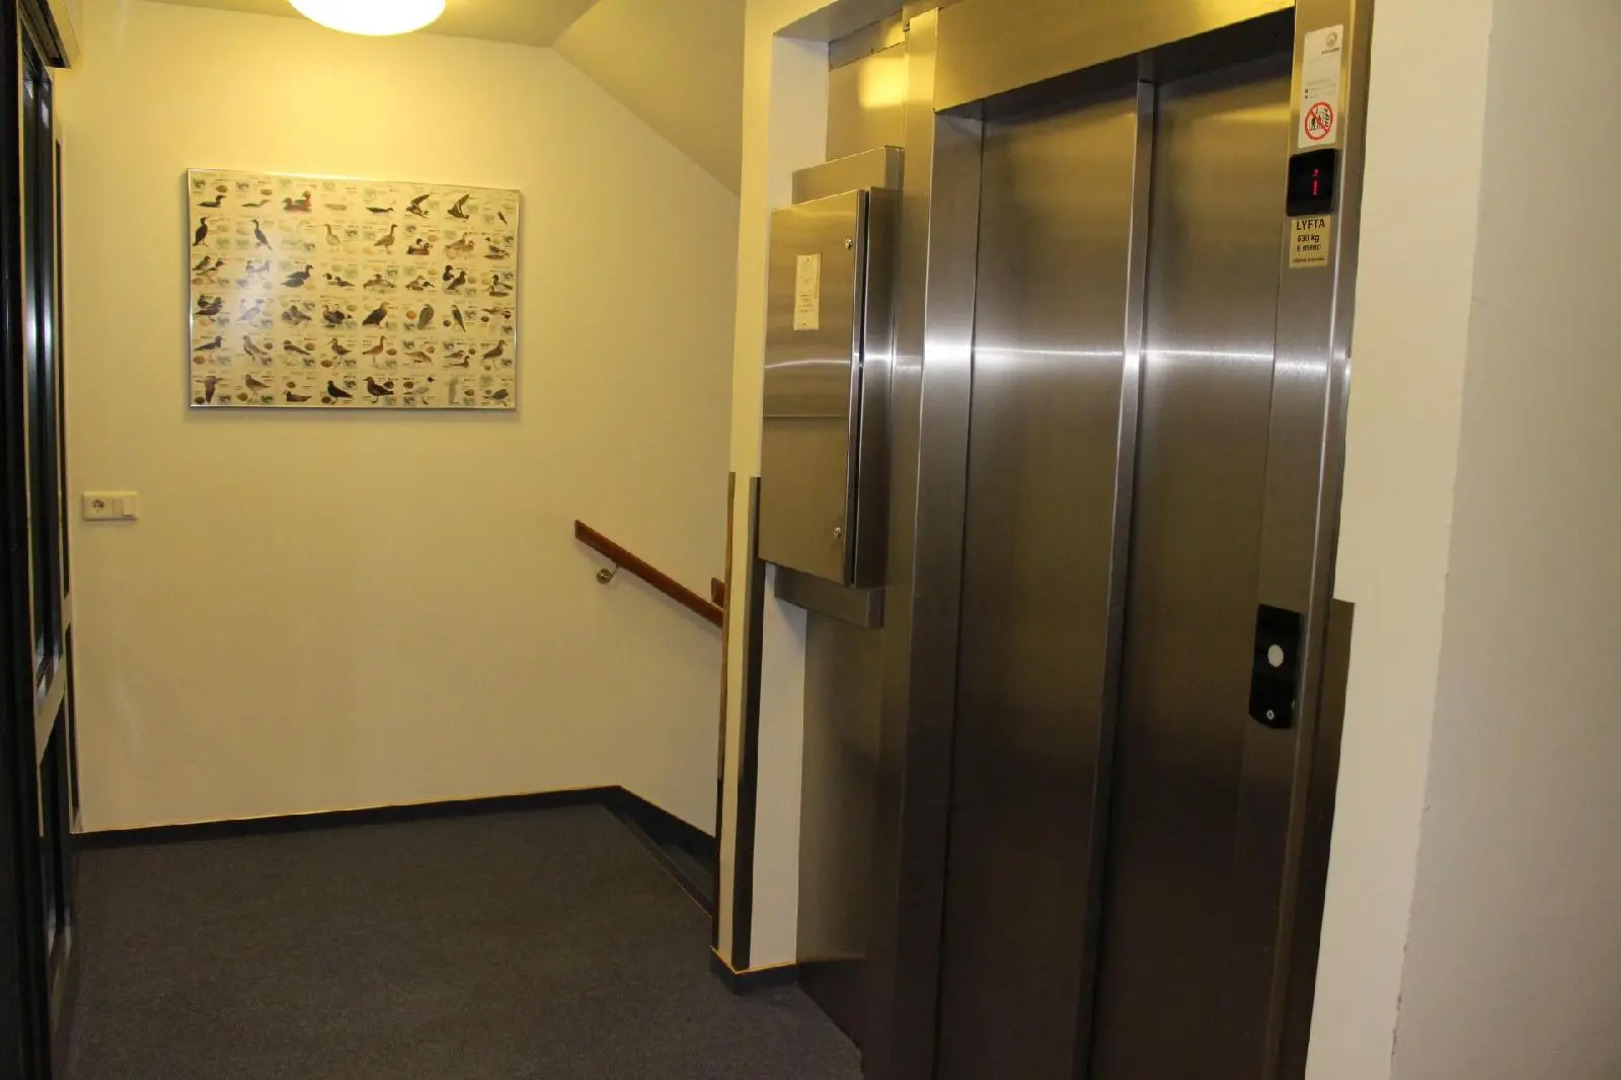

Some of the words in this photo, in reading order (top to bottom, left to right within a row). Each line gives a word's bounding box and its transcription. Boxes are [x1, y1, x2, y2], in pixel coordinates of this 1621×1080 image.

[1296, 218, 1325, 231] LYFTA
[1297, 234, 1310, 242] 630
[1310, 233, 1320, 243] kg
